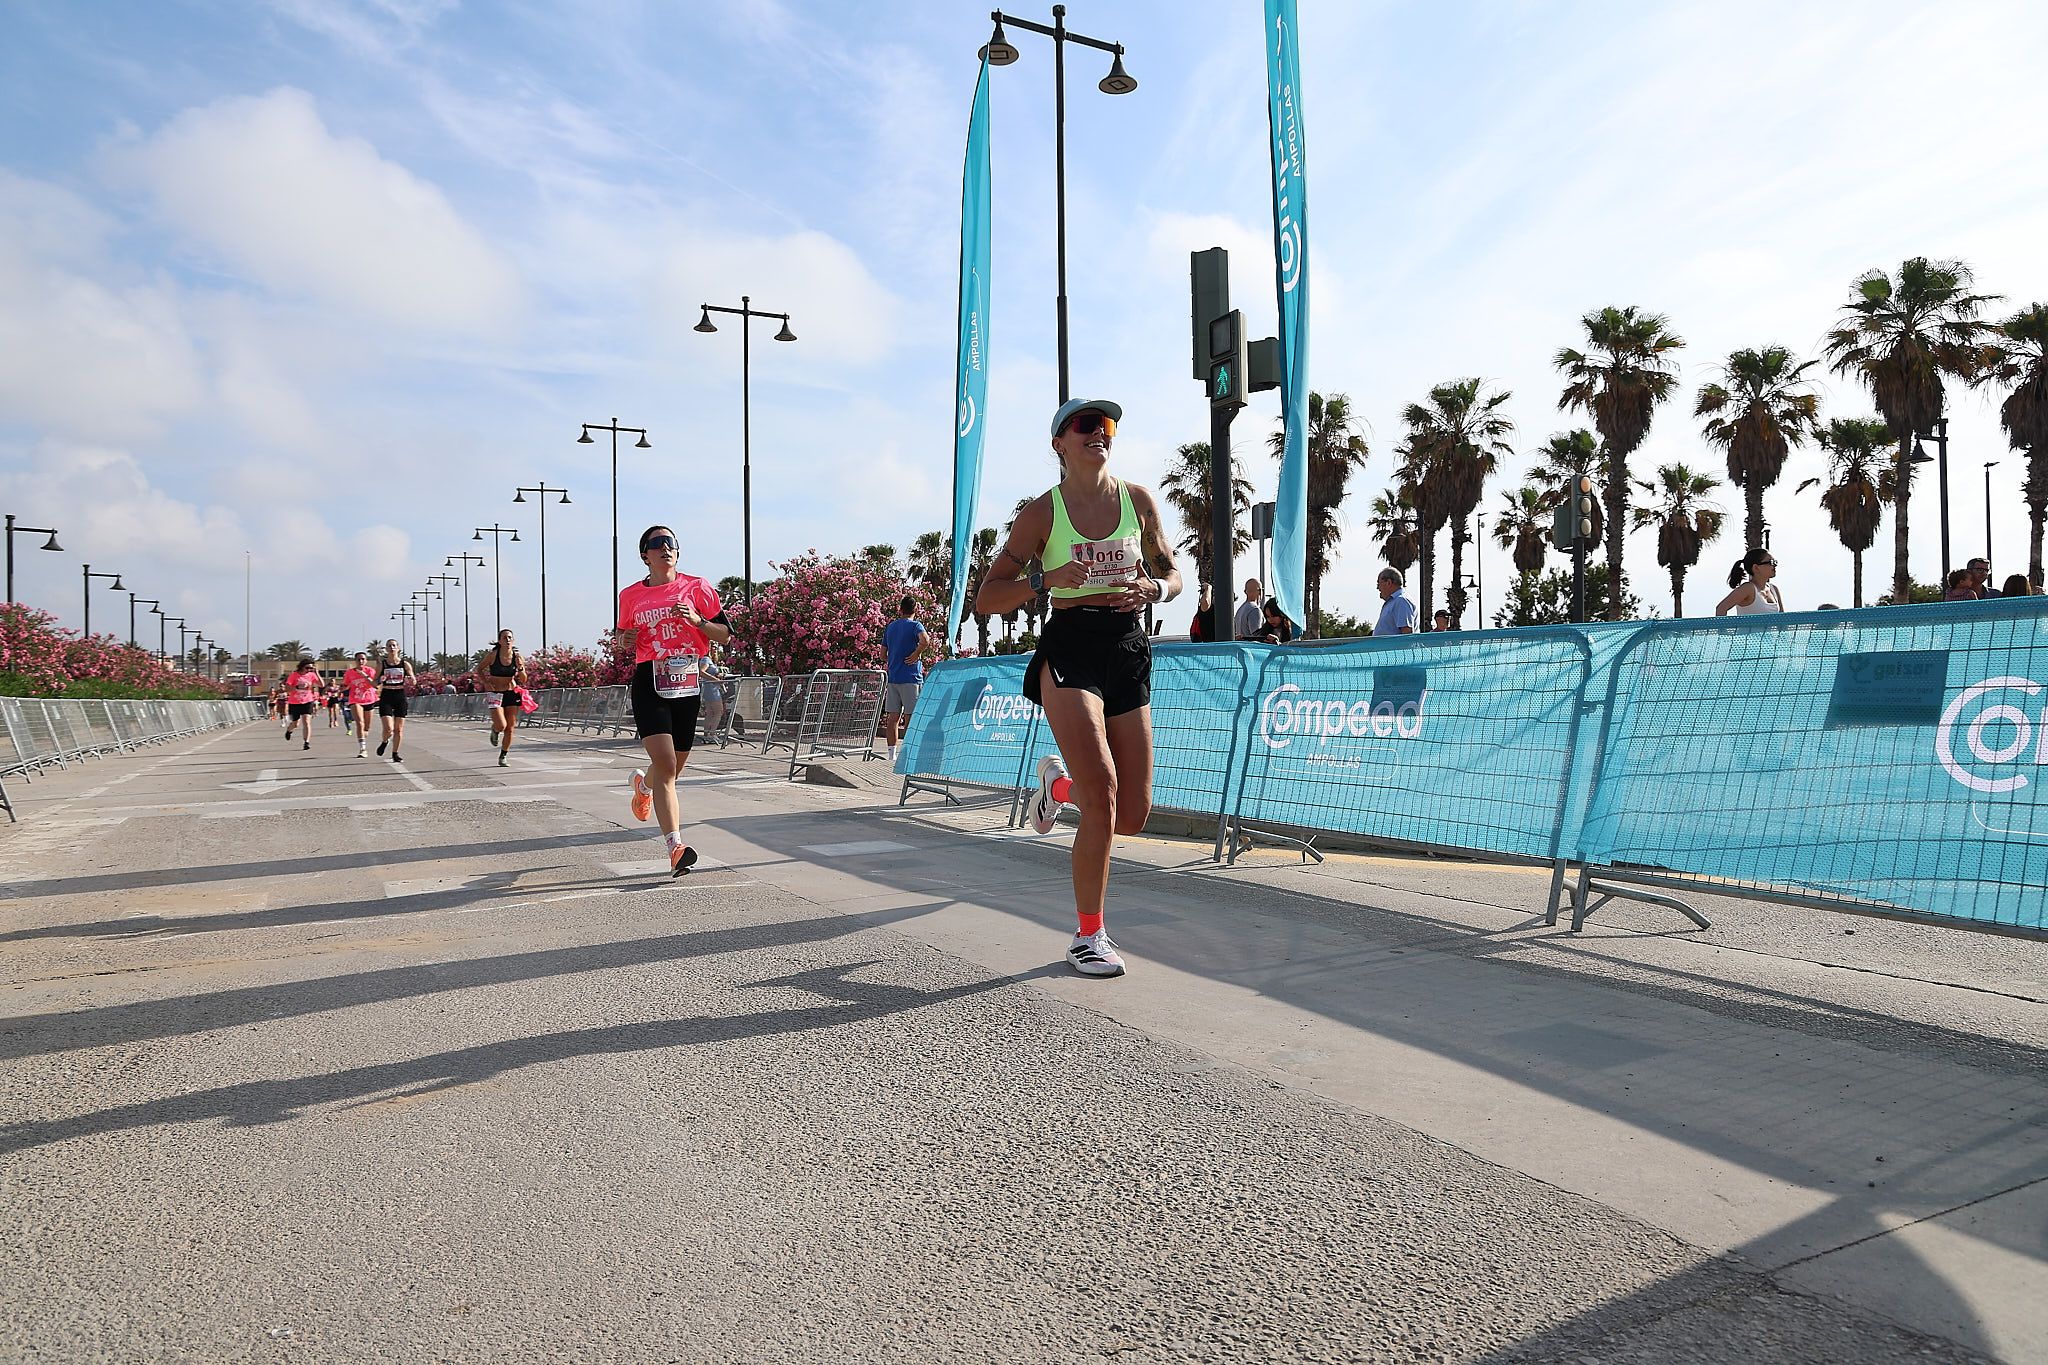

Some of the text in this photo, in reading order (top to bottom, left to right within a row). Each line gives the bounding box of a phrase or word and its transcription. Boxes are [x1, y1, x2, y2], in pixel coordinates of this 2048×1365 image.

[1283, 84, 1301, 177] AMPOLLAS
[1096, 550, 1124, 562] 016
[635, 606, 679, 625] CARRER
[662, 623, 677, 640] DE
[1261, 683, 1428, 749] Compeed
[991, 732, 1016, 742] AMPOLLAS
[1307, 753, 1361, 769] AMPOLLAS
